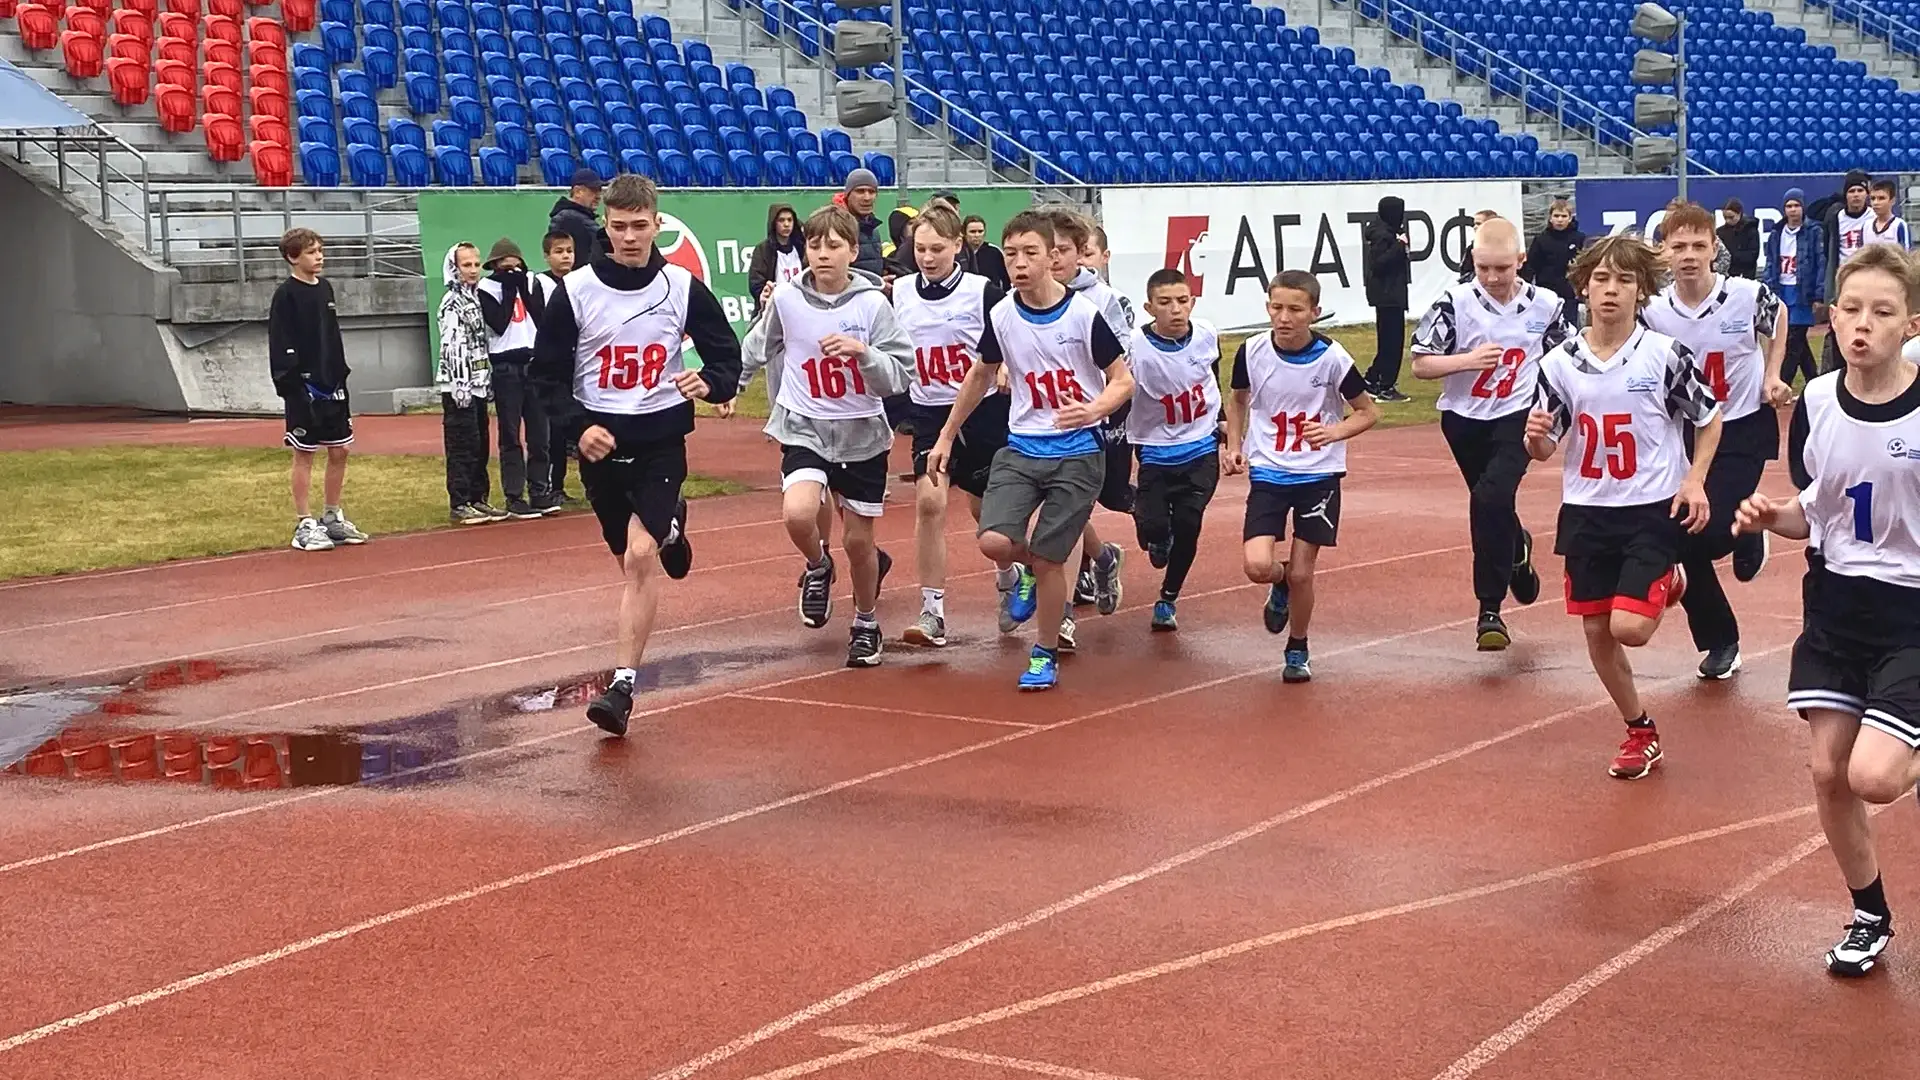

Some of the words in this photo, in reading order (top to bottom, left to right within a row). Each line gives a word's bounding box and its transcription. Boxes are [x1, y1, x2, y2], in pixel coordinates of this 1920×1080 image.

[595, 343, 668, 391] 158
[802, 356, 866, 399] 161
[916, 343, 972, 387] 145
[1024, 367, 1085, 410] 115
[1161, 383, 1209, 425] 112
[1579, 413, 1637, 481] 25
[1845, 481, 1874, 543] 1
